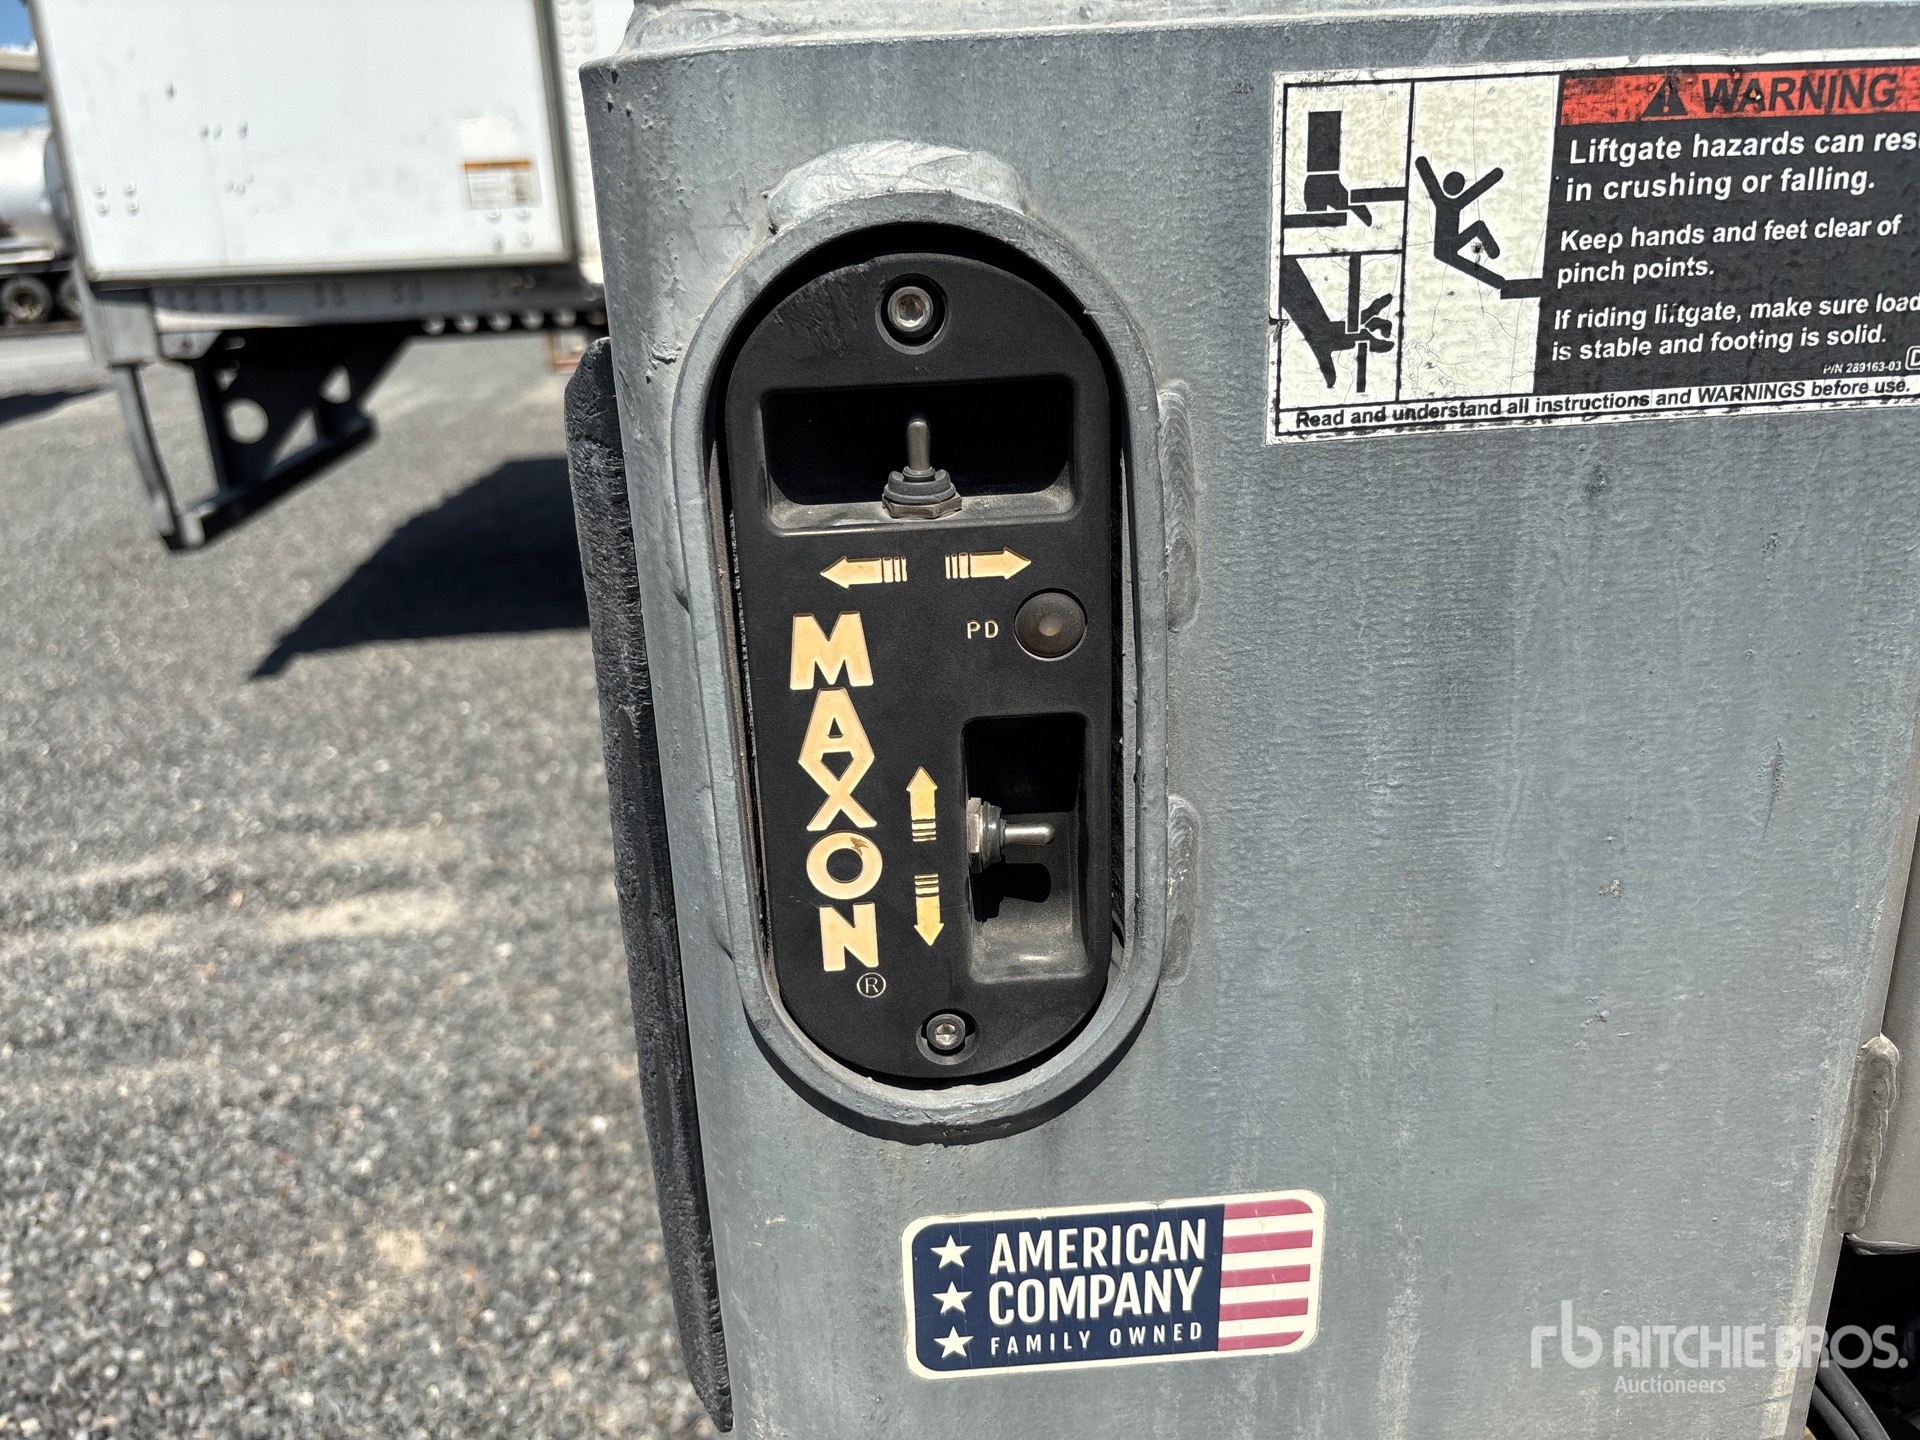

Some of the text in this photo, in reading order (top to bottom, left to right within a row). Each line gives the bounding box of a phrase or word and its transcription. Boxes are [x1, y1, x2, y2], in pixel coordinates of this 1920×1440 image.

[1701, 73, 1898, 113] WARNING
[1569, 131, 1920, 167] Liftgate hazards can res
[1566, 166, 1875, 201] in crushing or falling.
[1560, 214, 1902, 254] Keep hands and feet clear of
[1557, 256, 1715, 289] pinch points.
[1554, 310, 1570, 330] If
[1576, 305, 1647, 330] riding
[1750, 297, 1812, 319] make
[1818, 297, 1869, 316] sure
[1876, 293, 1920, 313] load
[1551, 324, 1887, 361] is stable and footing is solid.
[1846, 361, 1901, 373] 289163-03
[1296, 379, 1910, 429] Read and understand all instructions and WARNINGS before use.
[967, 619, 999, 639] PD
[790, 611, 883, 972] MAXON
[989, 1218, 1206, 1275] AMERICAN
[988, 1266, 1203, 1325] COMPANY
[991, 1321, 1202, 1357] FAMILY OWNED
